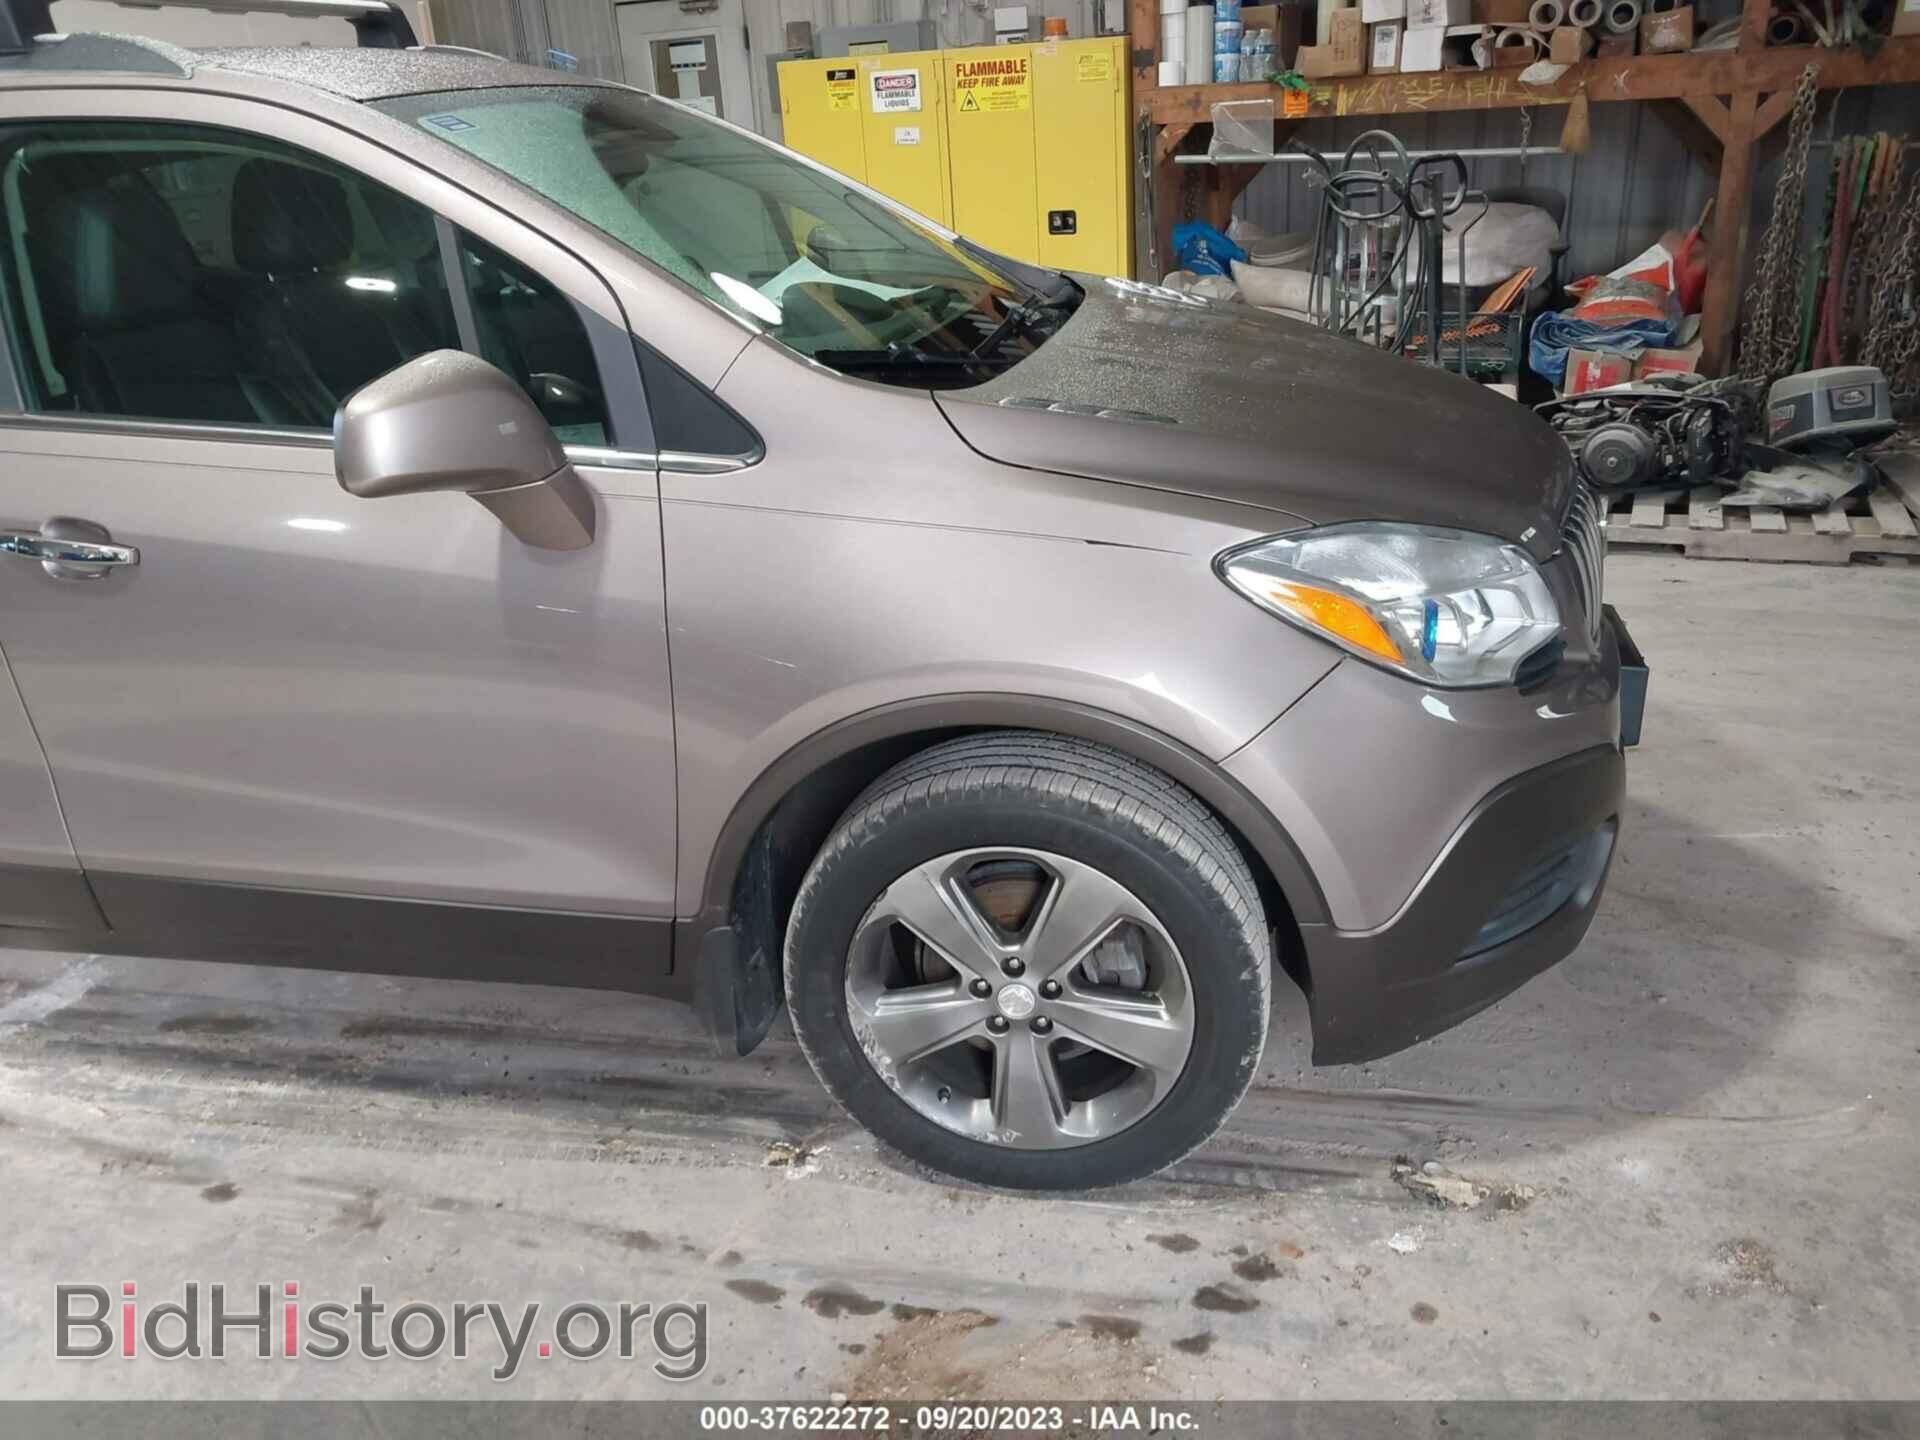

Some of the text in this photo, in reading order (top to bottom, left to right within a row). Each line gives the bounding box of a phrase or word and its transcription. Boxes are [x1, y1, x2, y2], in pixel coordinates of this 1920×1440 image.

[956, 59, 1027, 77] FLAMMABLE
[879, 76, 912, 89] DANGER
[957, 75, 1026, 89] KEEP FIRE AWAY
[877, 89, 916, 99] FLAMMABLE
[884, 99, 910, 108] LIQUIDS
